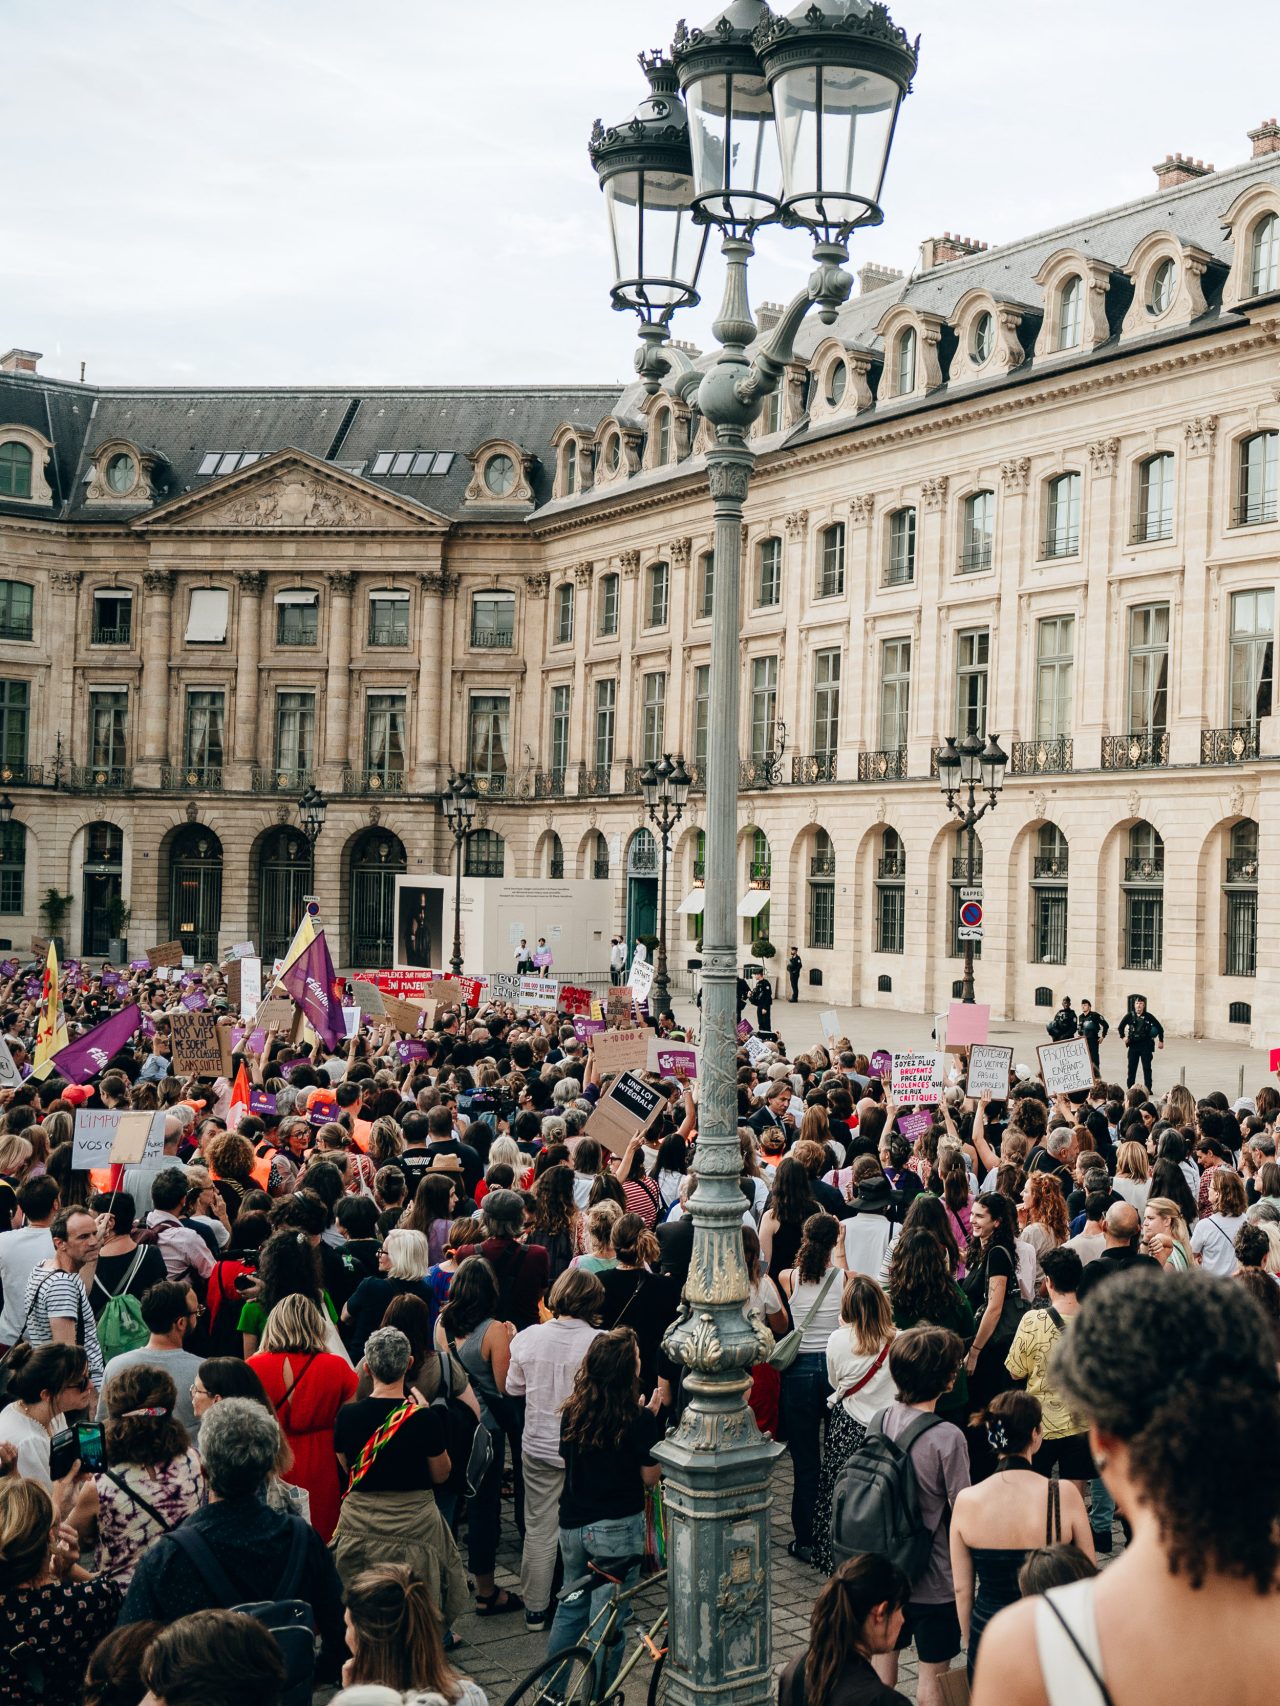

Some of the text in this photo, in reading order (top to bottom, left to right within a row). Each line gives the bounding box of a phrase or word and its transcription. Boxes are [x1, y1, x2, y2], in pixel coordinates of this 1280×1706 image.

[173, 1014, 214, 1027] POUR QUE
[173, 1027, 214, 1039] NOS VIES
[177, 1049, 195, 1059] PLUS
[1042, 1043, 1087, 1061] PROTÉGER
[180, 1060, 222, 1071] SANS SUITE
[894, 1059, 936, 1068] SOYEZ PLUS
[984, 1060, 1008, 1069] VICTIMES
[1052, 1060, 1084, 1075] ENFANTS
[900, 1067, 933, 1075] BRUYANTS
[627, 1078, 653, 1100] UNE LOI
[893, 1081, 929, 1089] VIOLENCES
[618, 1082, 654, 1111] INTÉGRALE
[899, 1093, 938, 1101] CRITIQUES
[80, 1113, 119, 1129] L'IMPU
[79, 1140, 102, 1150] VOS
